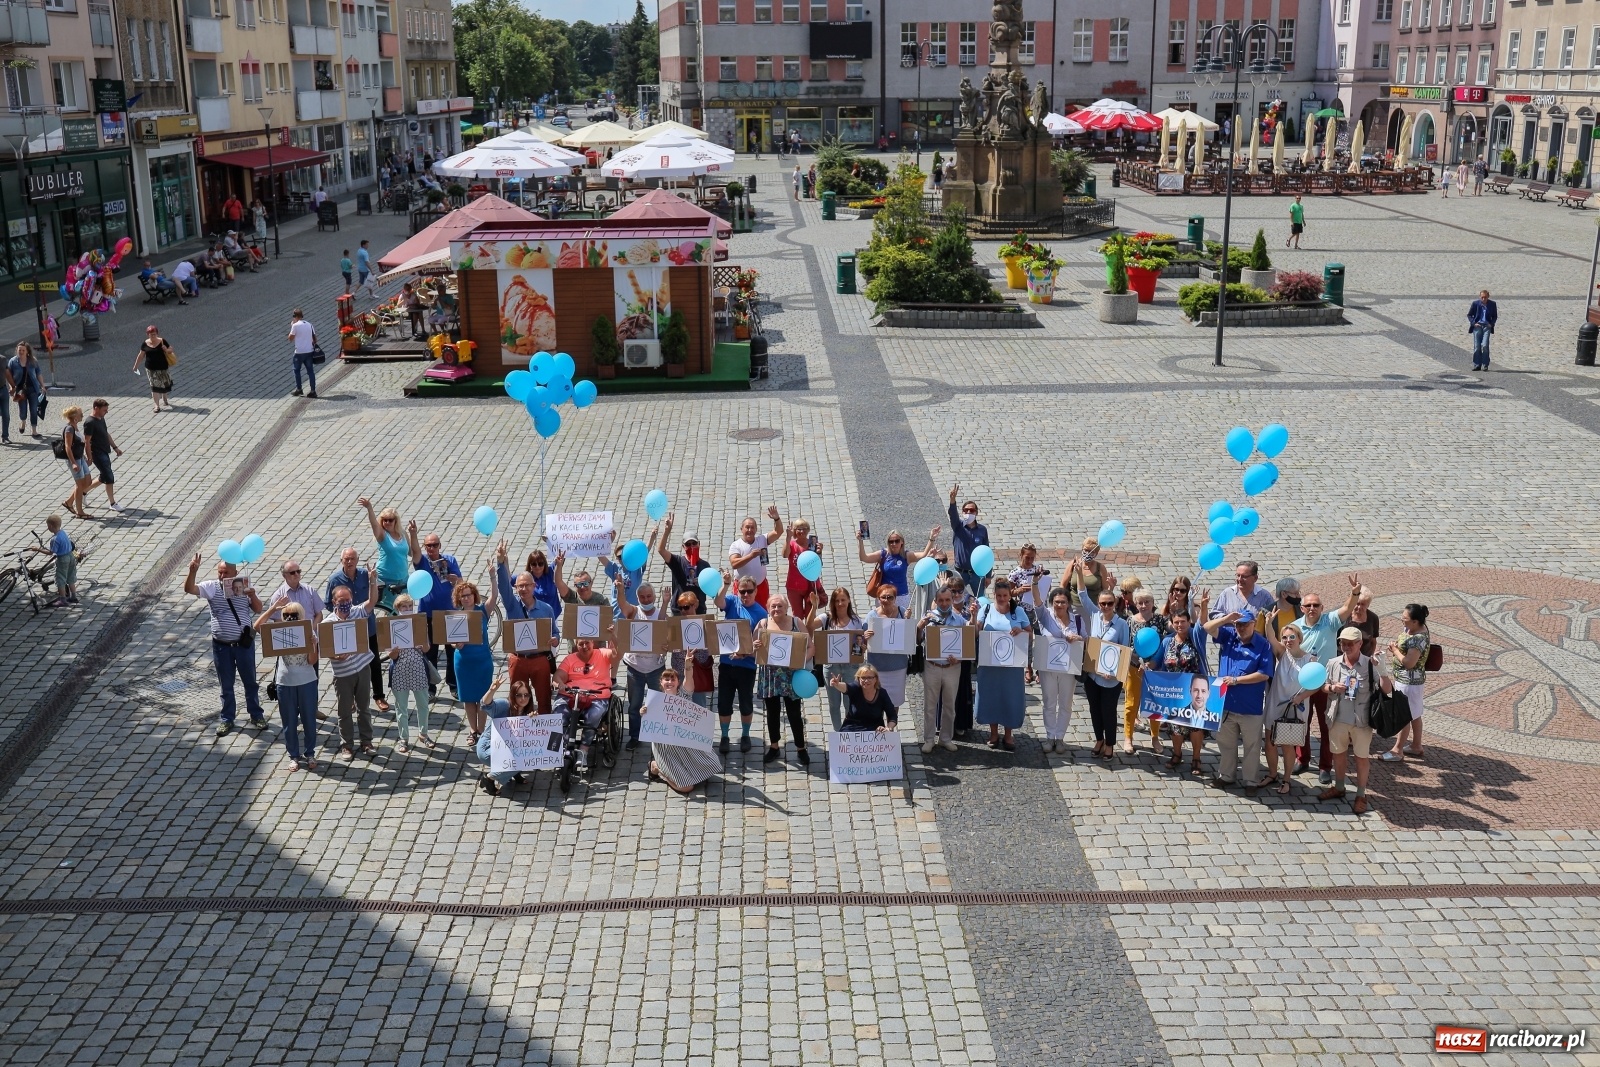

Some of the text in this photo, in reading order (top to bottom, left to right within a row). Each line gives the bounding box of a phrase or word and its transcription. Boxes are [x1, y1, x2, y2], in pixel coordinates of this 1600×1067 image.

[1414, 87, 1440, 99] KANTOR
[29, 171, 84, 193] JUBILER
[103, 201, 124, 214] CASIO
[589, 513, 606, 521] DAMA
[662, 705, 702, 722] NA NASZE
[1144, 700, 1220, 723] TRZASKOWSKI
[500, 718, 530, 729] KONIEC
[666, 713, 698, 727] TROSKI
[641, 720, 669, 736] RAFAŁ
[840, 733, 851, 743] NA
[838, 745, 851, 754] NIE
[838, 766, 864, 776] DOBRZE
